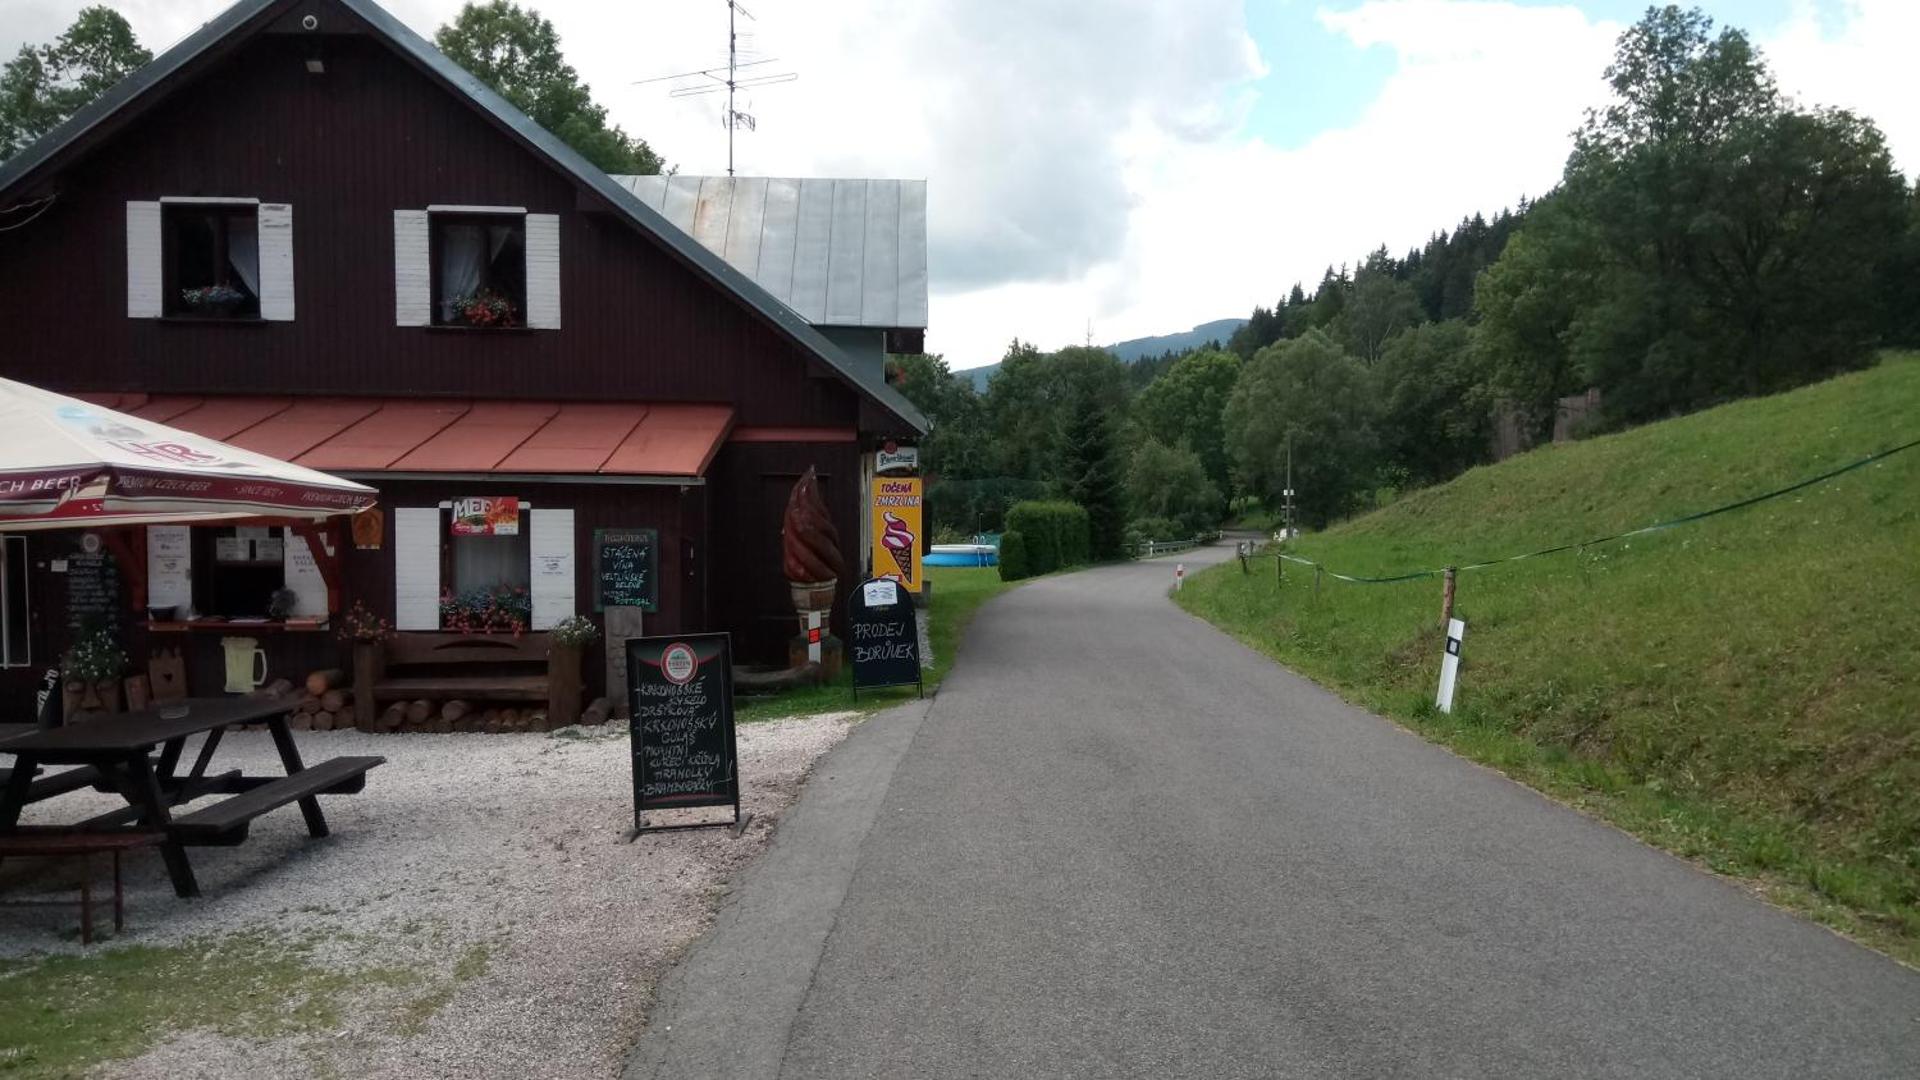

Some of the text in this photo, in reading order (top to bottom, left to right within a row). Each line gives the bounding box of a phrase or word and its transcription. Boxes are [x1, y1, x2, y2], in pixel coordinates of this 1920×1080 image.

[31, 476, 81, 492] BEER
[881, 481, 912, 493] TOČENÁ
[875, 495, 920, 506] ZMRZLINA
[603, 545, 649, 560] STÁČENÁ
[612, 559, 634, 570] VÍNA
[853, 622, 905, 639] PRODEJ
[855, 640, 915, 662] BORŮVEK
